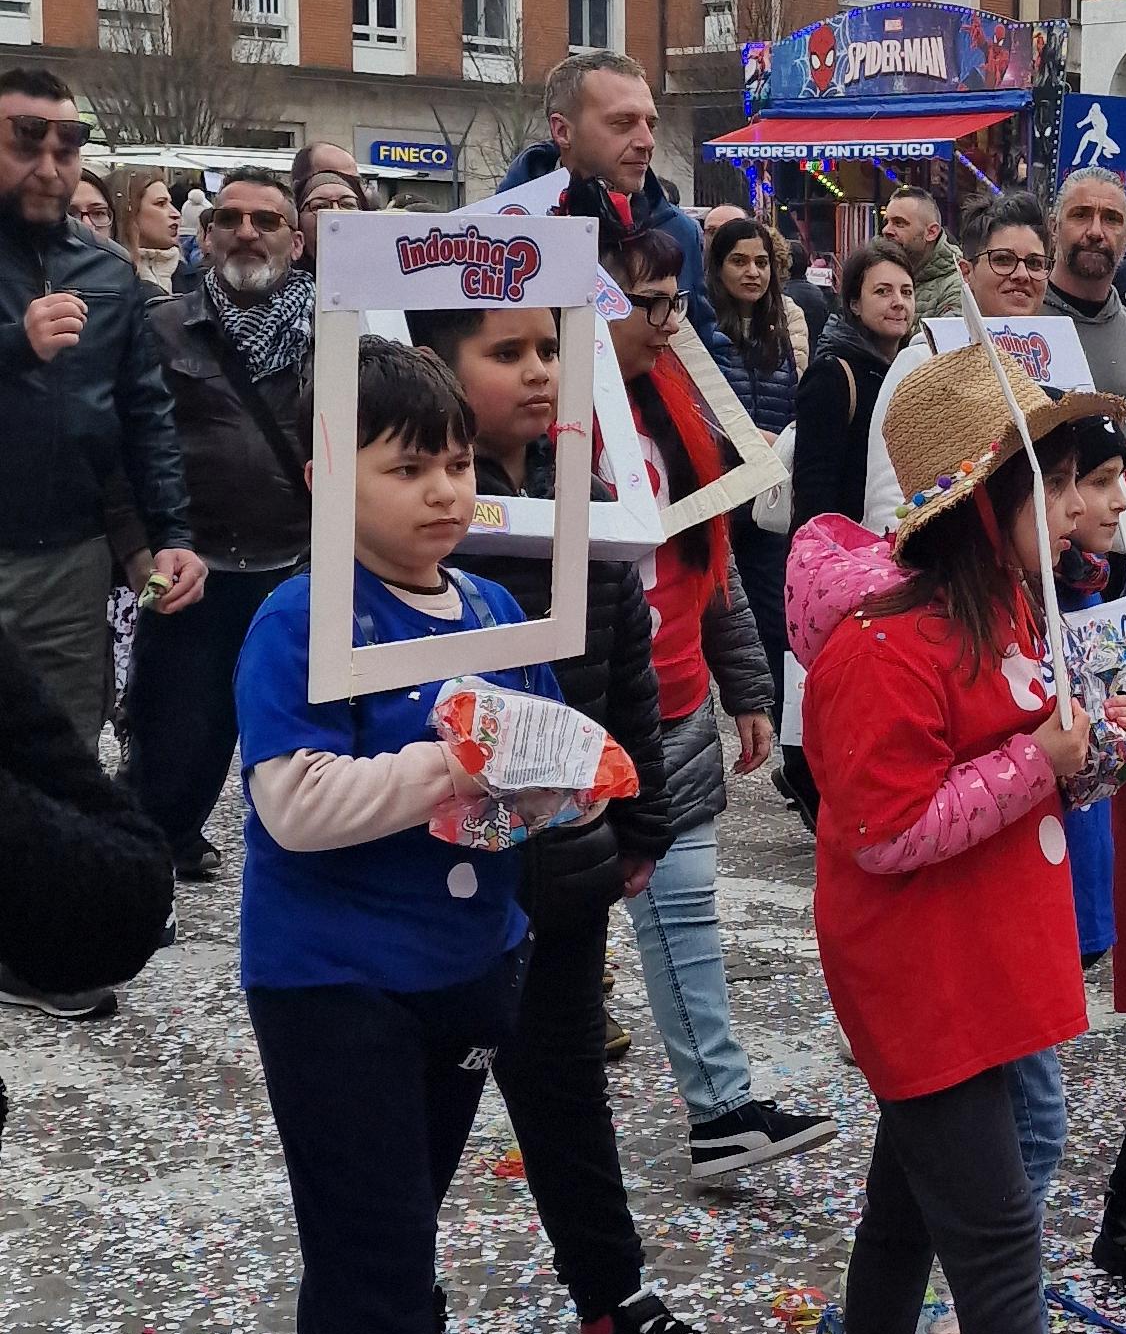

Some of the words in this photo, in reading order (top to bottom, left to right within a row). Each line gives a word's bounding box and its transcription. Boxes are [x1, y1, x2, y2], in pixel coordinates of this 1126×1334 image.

[380, 145, 447, 164] FINECO
[715, 146, 807, 158] PERCORSO
[813, 144, 935, 157] FANTASTICO
